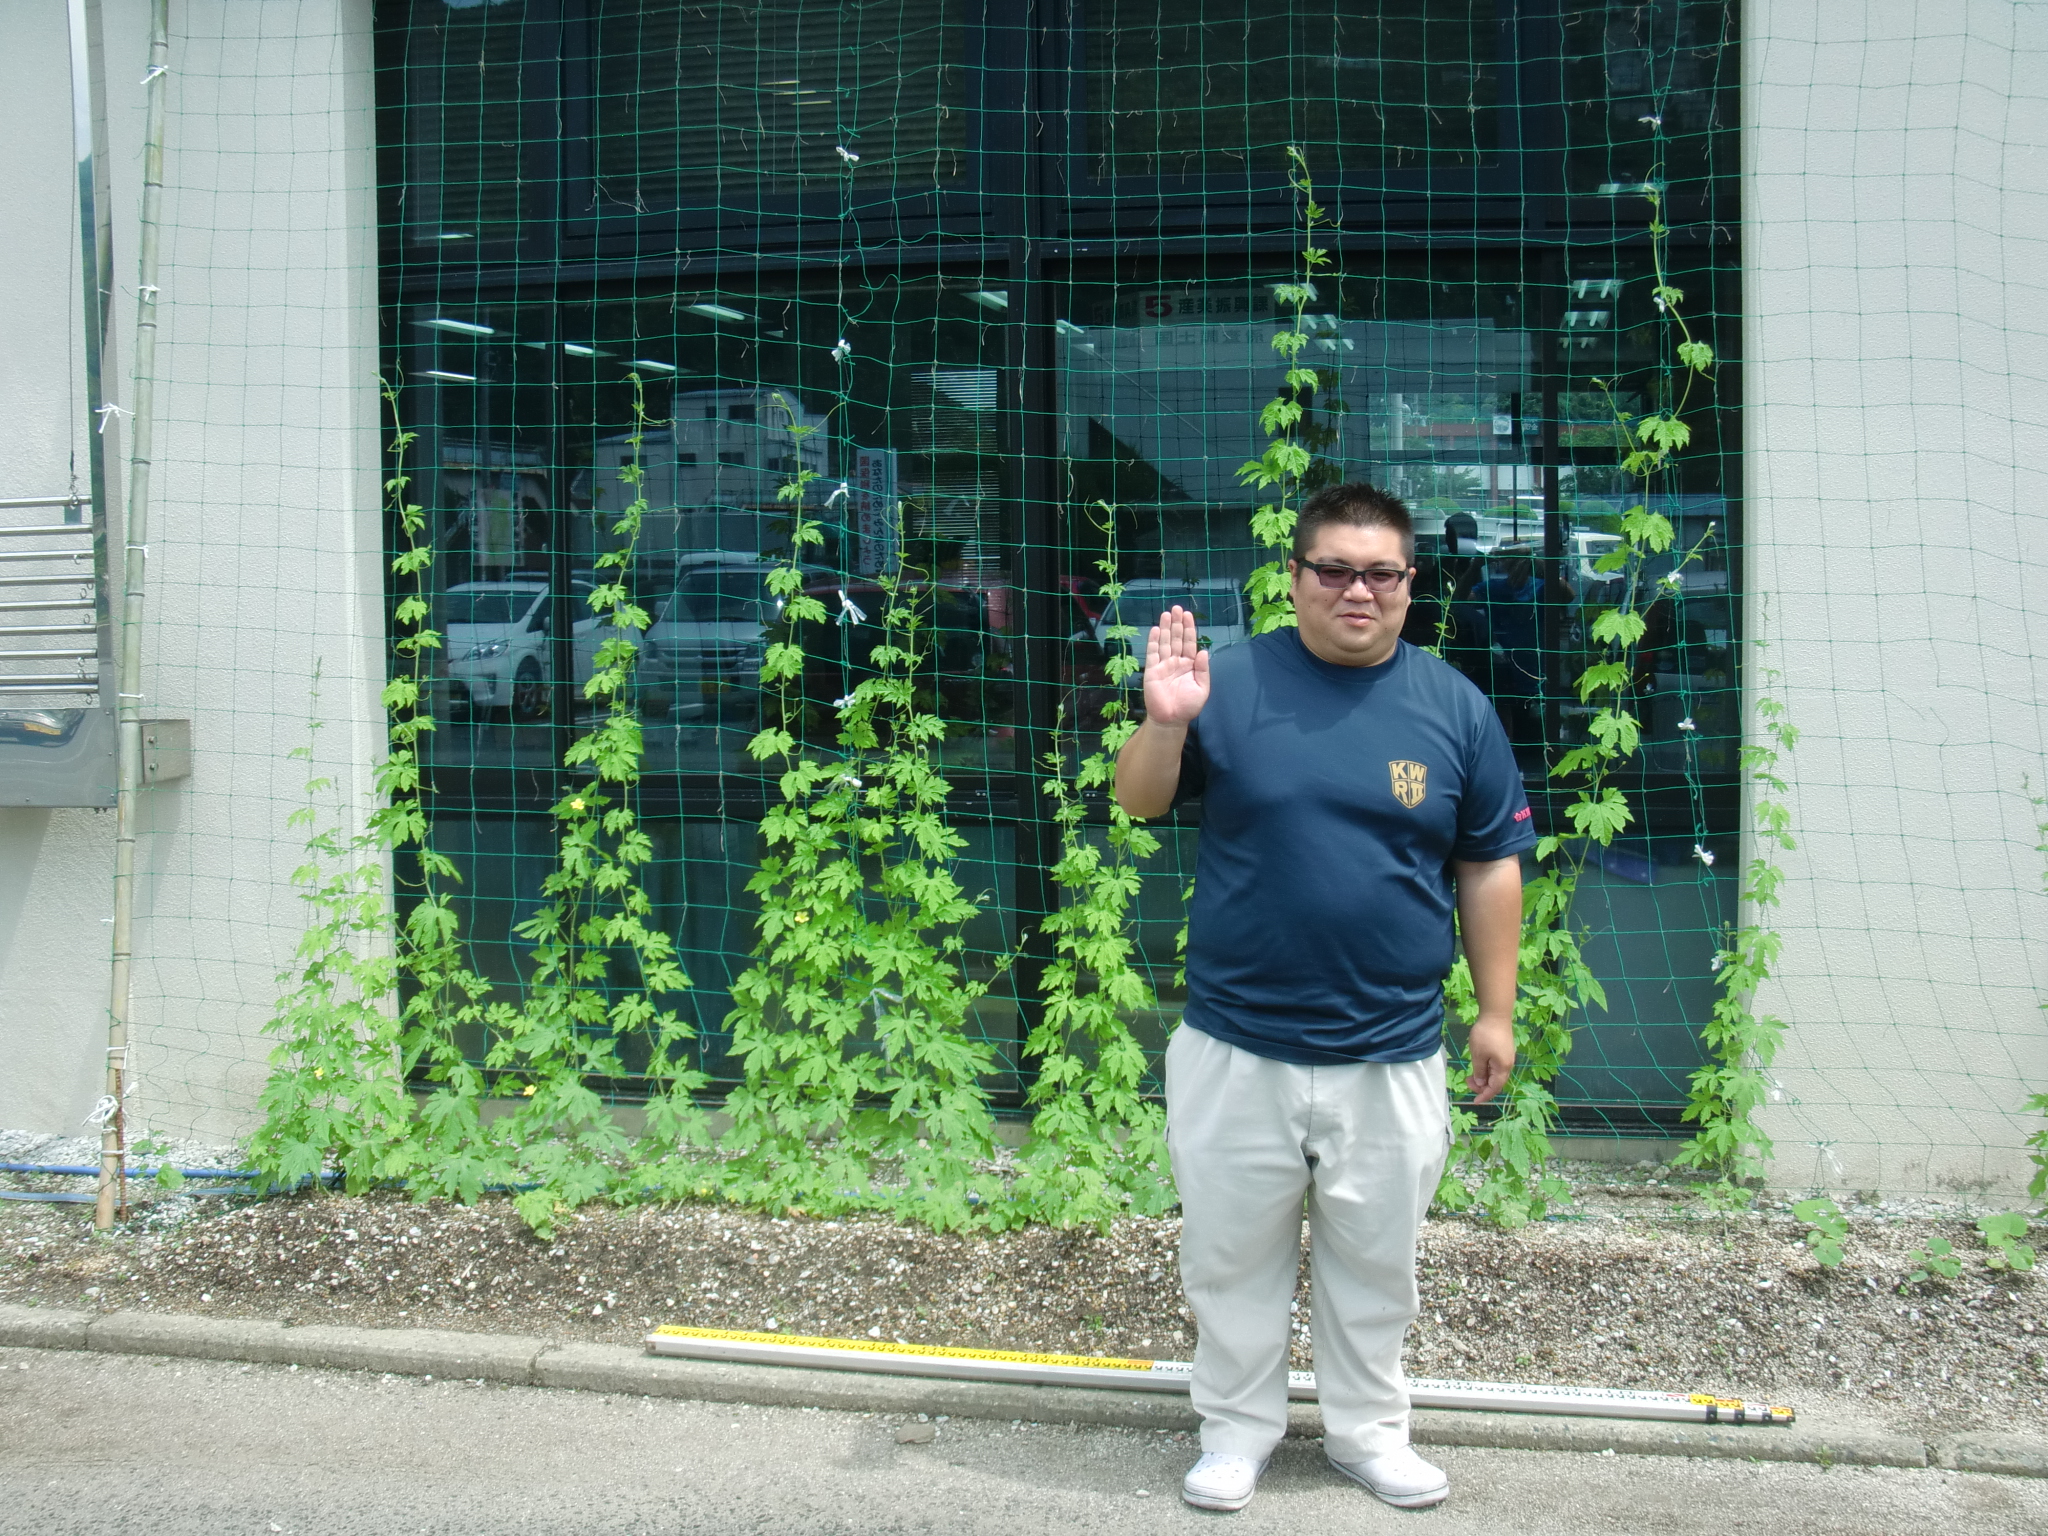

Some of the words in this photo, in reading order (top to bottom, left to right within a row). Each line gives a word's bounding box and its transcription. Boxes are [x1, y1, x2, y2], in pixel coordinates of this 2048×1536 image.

[1145, 295, 1173, 318] 5
[1178, 296, 1269, 315] 産業振興課
